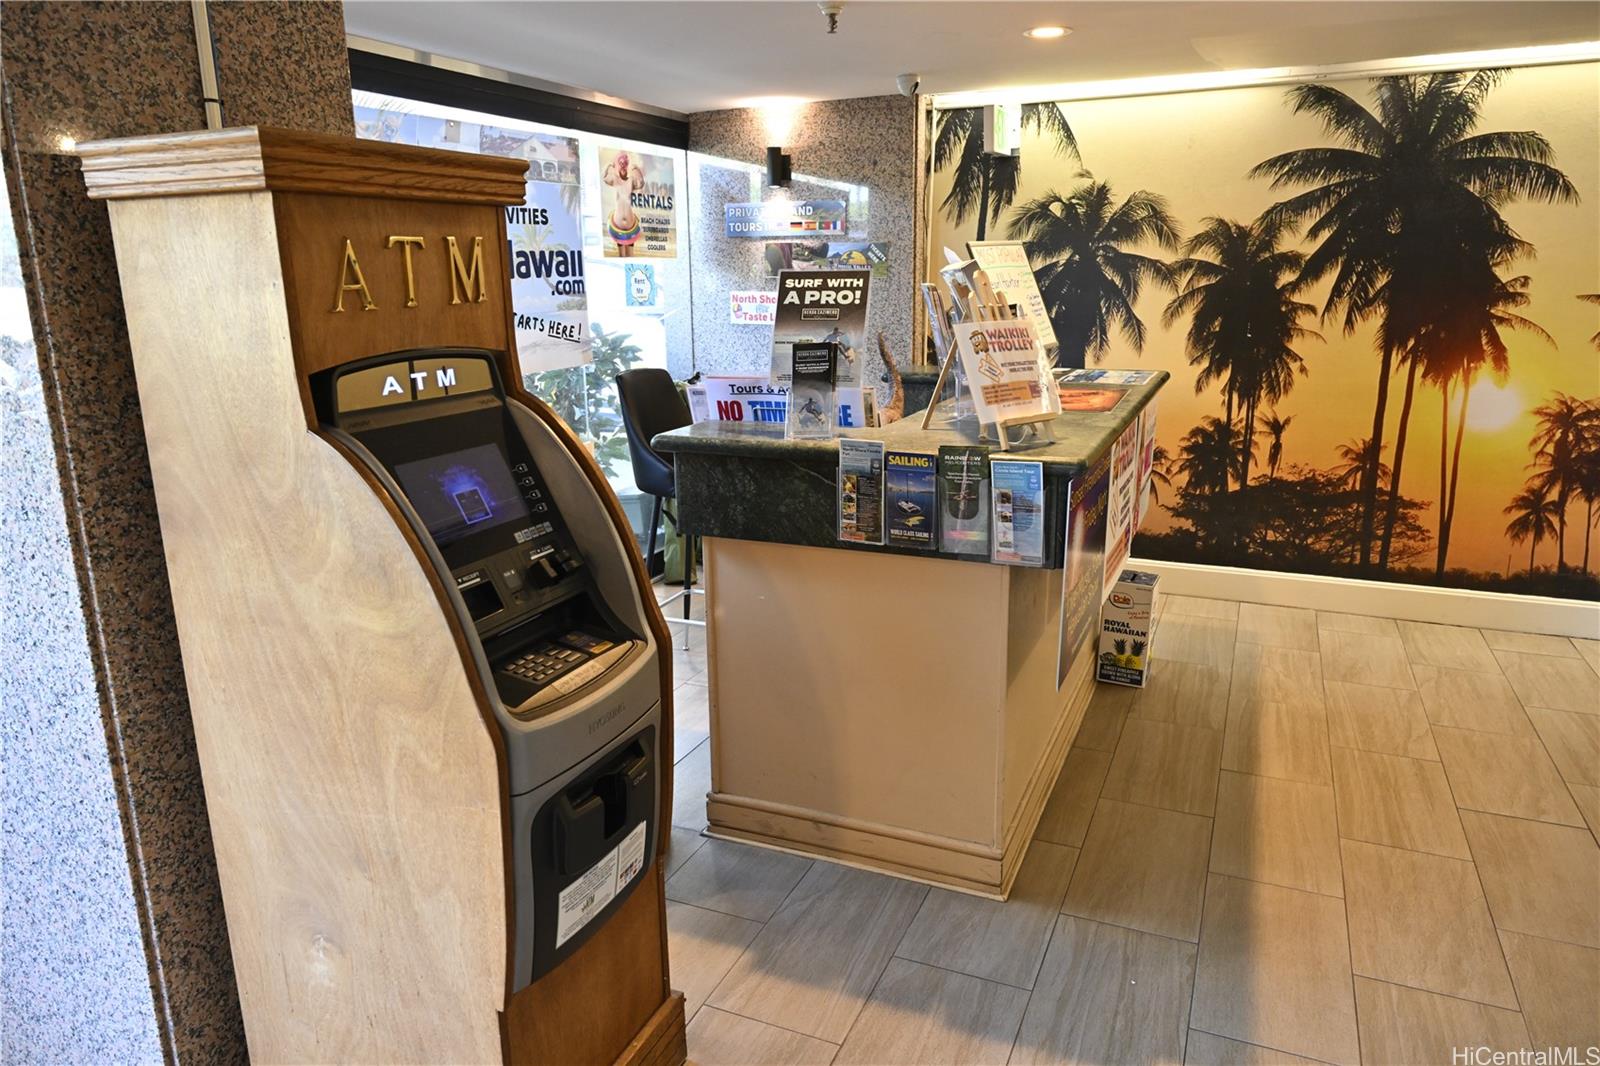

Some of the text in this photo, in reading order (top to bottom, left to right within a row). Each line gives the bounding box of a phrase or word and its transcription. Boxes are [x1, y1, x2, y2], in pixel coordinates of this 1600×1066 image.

[631, 192, 673, 210] RENTALS
[506, 207, 549, 226] VITIES
[729, 206, 767, 218] PRIVA
[729, 222, 762, 232] TOURS
[508, 239, 584, 280] awaii
[332, 235, 487, 312] ATM
[551, 278, 585, 296] .com
[785, 278, 864, 288] SURF WITH
[731, 294, 757, 304] North
[783, 290, 862, 305] A PRO!
[743, 312, 768, 322] Taste
[986, 327, 1030, 340] WAIKIKI
[989, 339, 1034, 353] TROLLEY
[382, 367, 457, 397] ATM
[729, 384, 763, 394] Tours
[717, 400, 744, 422] NO
[888, 454, 929, 468] SAILING
[1104, 618, 1131, 629] ROYAL
[1103, 625, 1146, 638] HAWAIIAN
